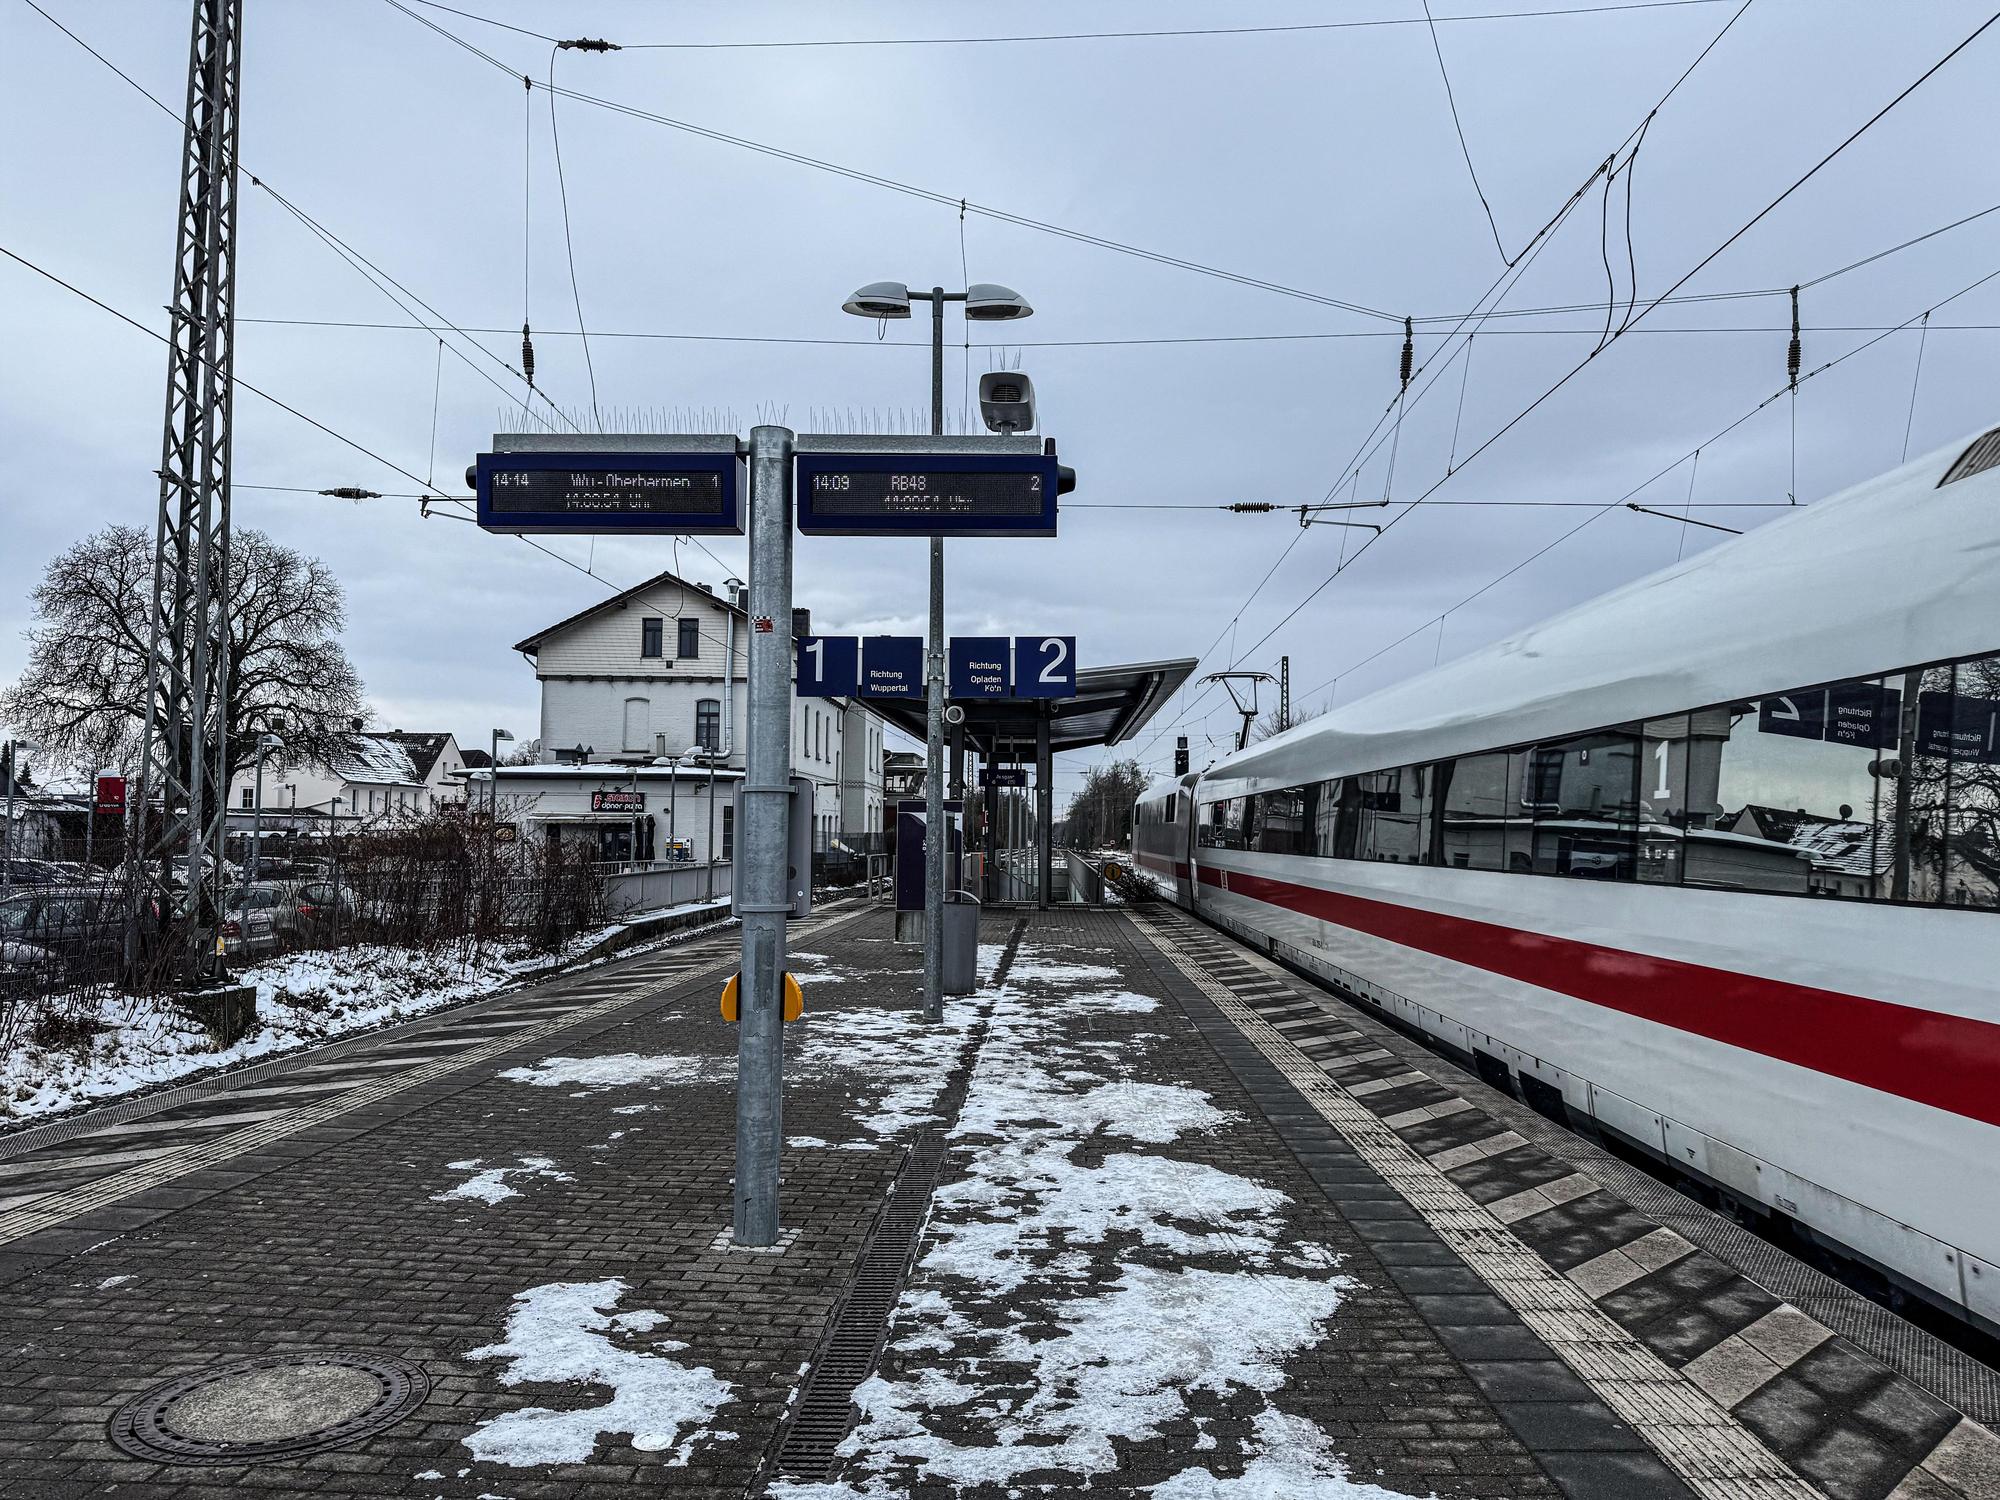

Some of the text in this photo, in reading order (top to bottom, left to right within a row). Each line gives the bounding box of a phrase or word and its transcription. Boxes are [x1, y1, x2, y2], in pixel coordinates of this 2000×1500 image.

[711, 475, 718, 487] 1
[813, 475, 1040, 491] 14:09 RB48 2
[806, 638, 824, 682] 1
[969, 661, 1002, 671] Richtung
[1038, 638, 1068, 683] 2
[870, 670, 903, 680] Richtung
[970, 675, 1002, 684] Opladen
[870, 684, 909, 693] Wuppertal
[1653, 740, 1670, 799] 1
